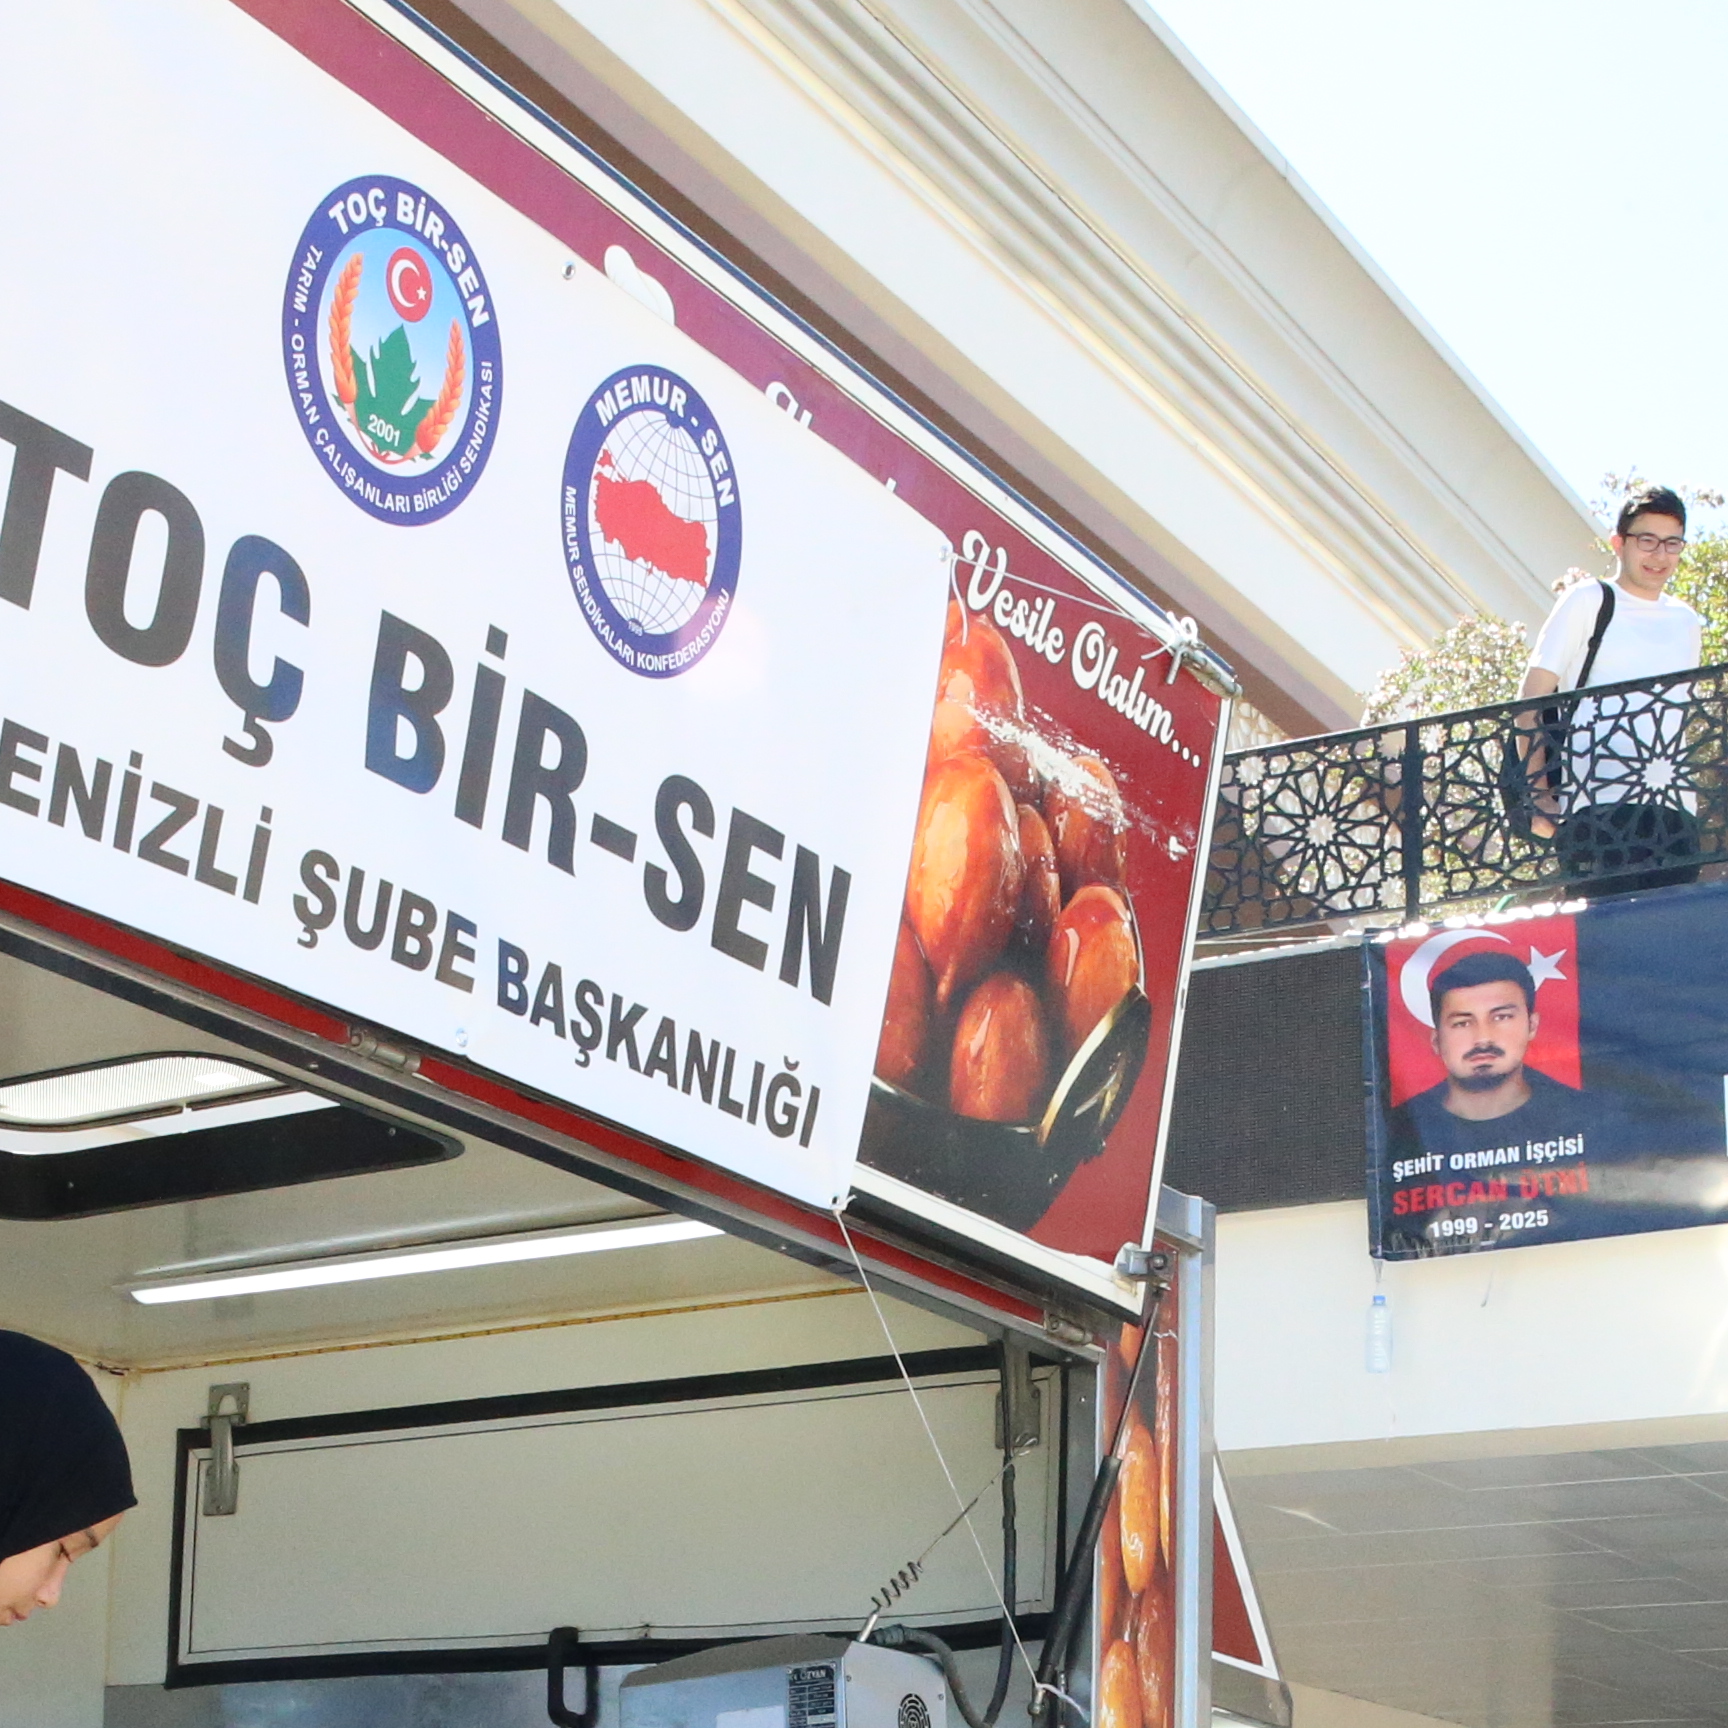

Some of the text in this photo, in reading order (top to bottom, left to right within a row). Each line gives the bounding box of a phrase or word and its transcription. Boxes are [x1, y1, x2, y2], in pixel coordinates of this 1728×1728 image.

[292, 244, 323, 314] TARIM
[329, 187, 491, 328] TOÇ BİR-SEN
[290, 332, 321, 426] ORMAN
[459, 360, 494, 473] SENDİKASI
[314, 427, 411, 514] ÇALIŞANLARI
[366, 413, 402, 448] 2001
[595, 375, 687, 427] MEMUR
[701, 428, 735, 508] SEN
[413, 464, 463, 513] BİRLİĞİ
[563, 485, 730, 672] MEMUR SENDİKALARI KONFEDERASYONU
[962, 529, 1066, 664] Vesile
[365, 608, 853, 1008] BİR-SEN
[292, 846, 479, 994] ŞUBE
[496, 938, 819, 1149] BAŞKANLIĞI
[1392, 1133, 1585, 1182] ŞEHİT ORMAN İŞÇİSİ
[1393, 1177, 1508, 1216] SERCAN
[1429, 1216, 1479, 1238] 1999
[1499, 1210, 1549, 1231] 2025
